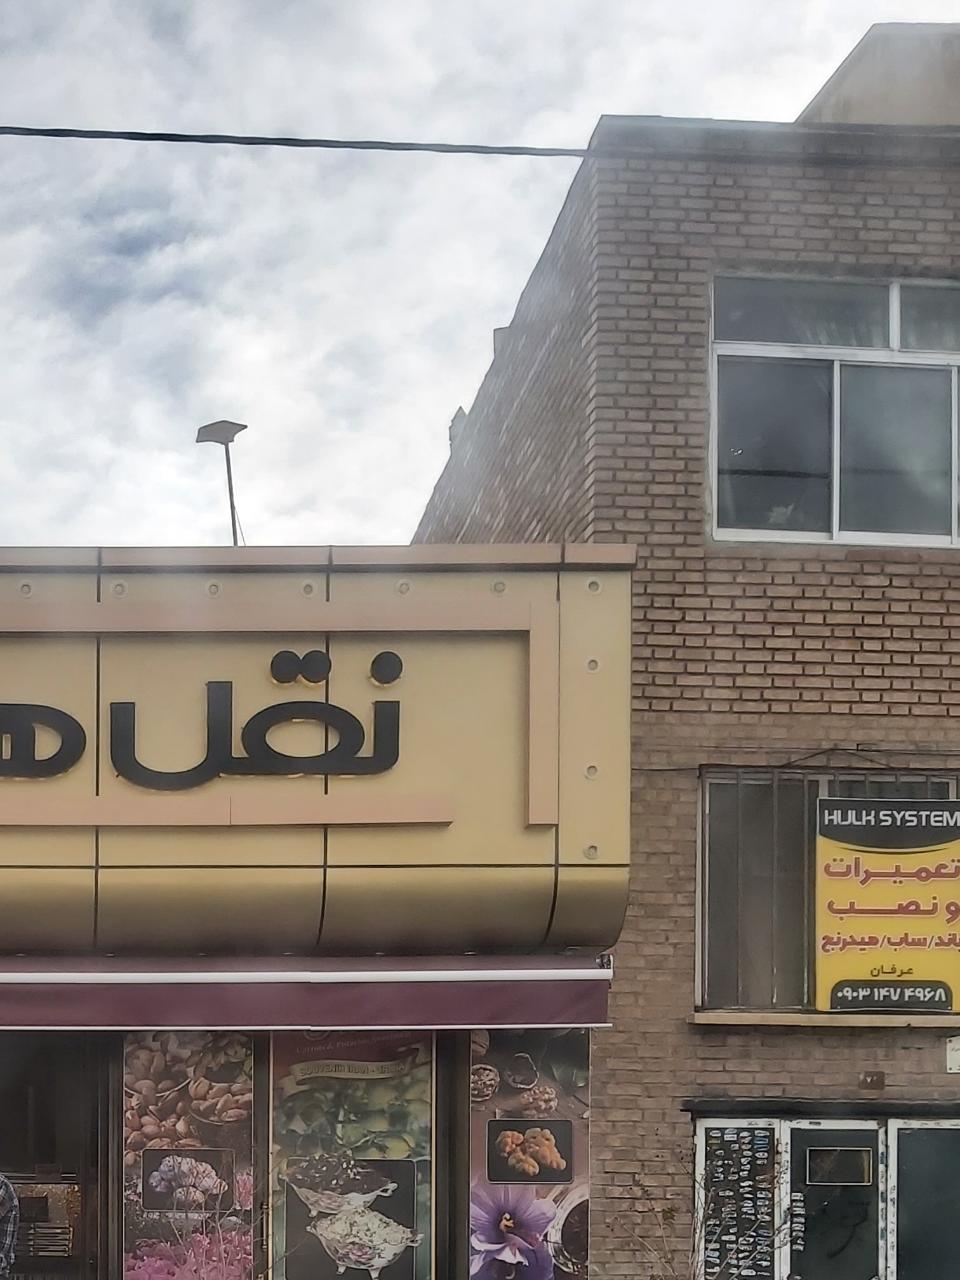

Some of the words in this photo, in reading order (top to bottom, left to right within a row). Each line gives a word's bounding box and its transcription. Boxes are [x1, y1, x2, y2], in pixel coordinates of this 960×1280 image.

[110, 650, 404, 791] نقل
[824, 809, 876, 826] HULK
[879, 810, 960, 827] SYSTEM
[824, 856, 960, 886] تعمیرات
[826, 895, 939, 921] نصب
[944, 900, 960, 924] و
[869, 963, 914, 977] عرفان
[836, 987, 871, 1001] ۰۹۰۳
[873, 987, 901, 1001] ۱۴۷
[903, 987, 946, 1001] ۴۹۶۸
